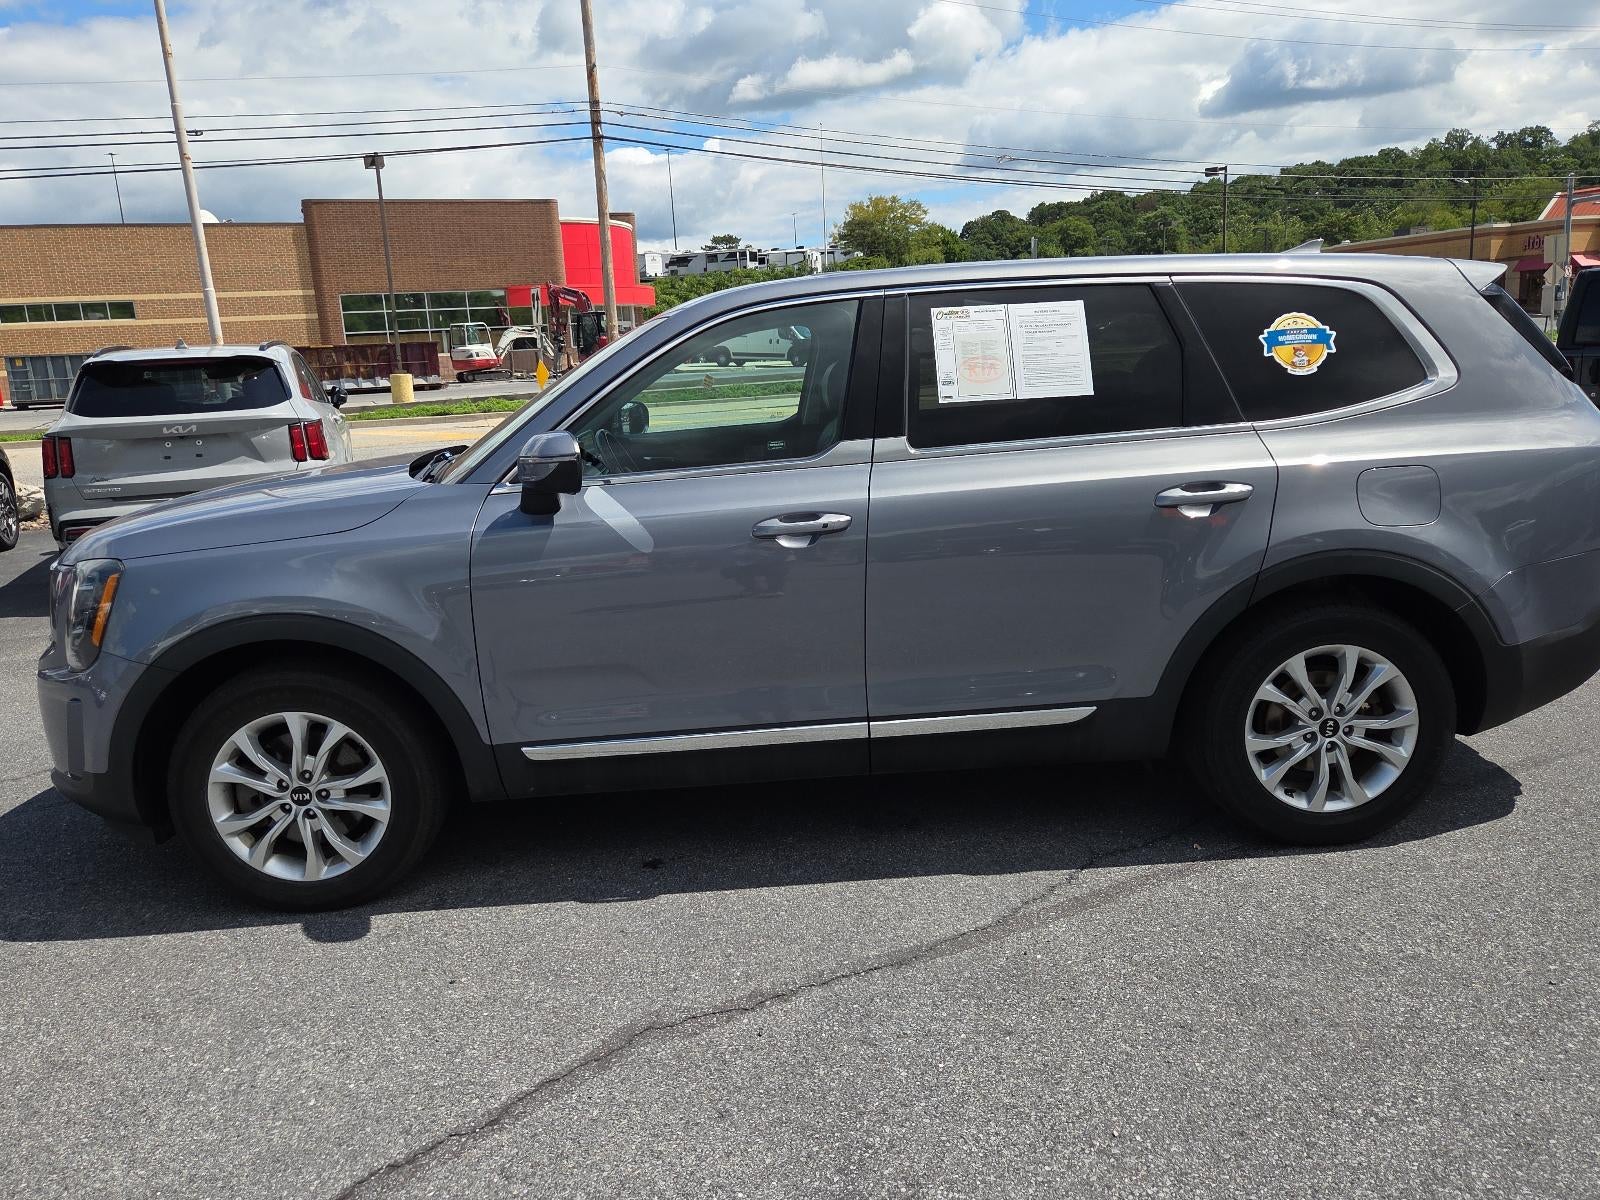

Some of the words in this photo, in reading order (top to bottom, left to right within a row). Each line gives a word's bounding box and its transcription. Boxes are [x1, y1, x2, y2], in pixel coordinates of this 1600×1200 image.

[1278, 334, 1317, 342] HOMEGROWN
[1325, 720, 1335, 737] KIA
[292, 793, 310, 801] KIA
